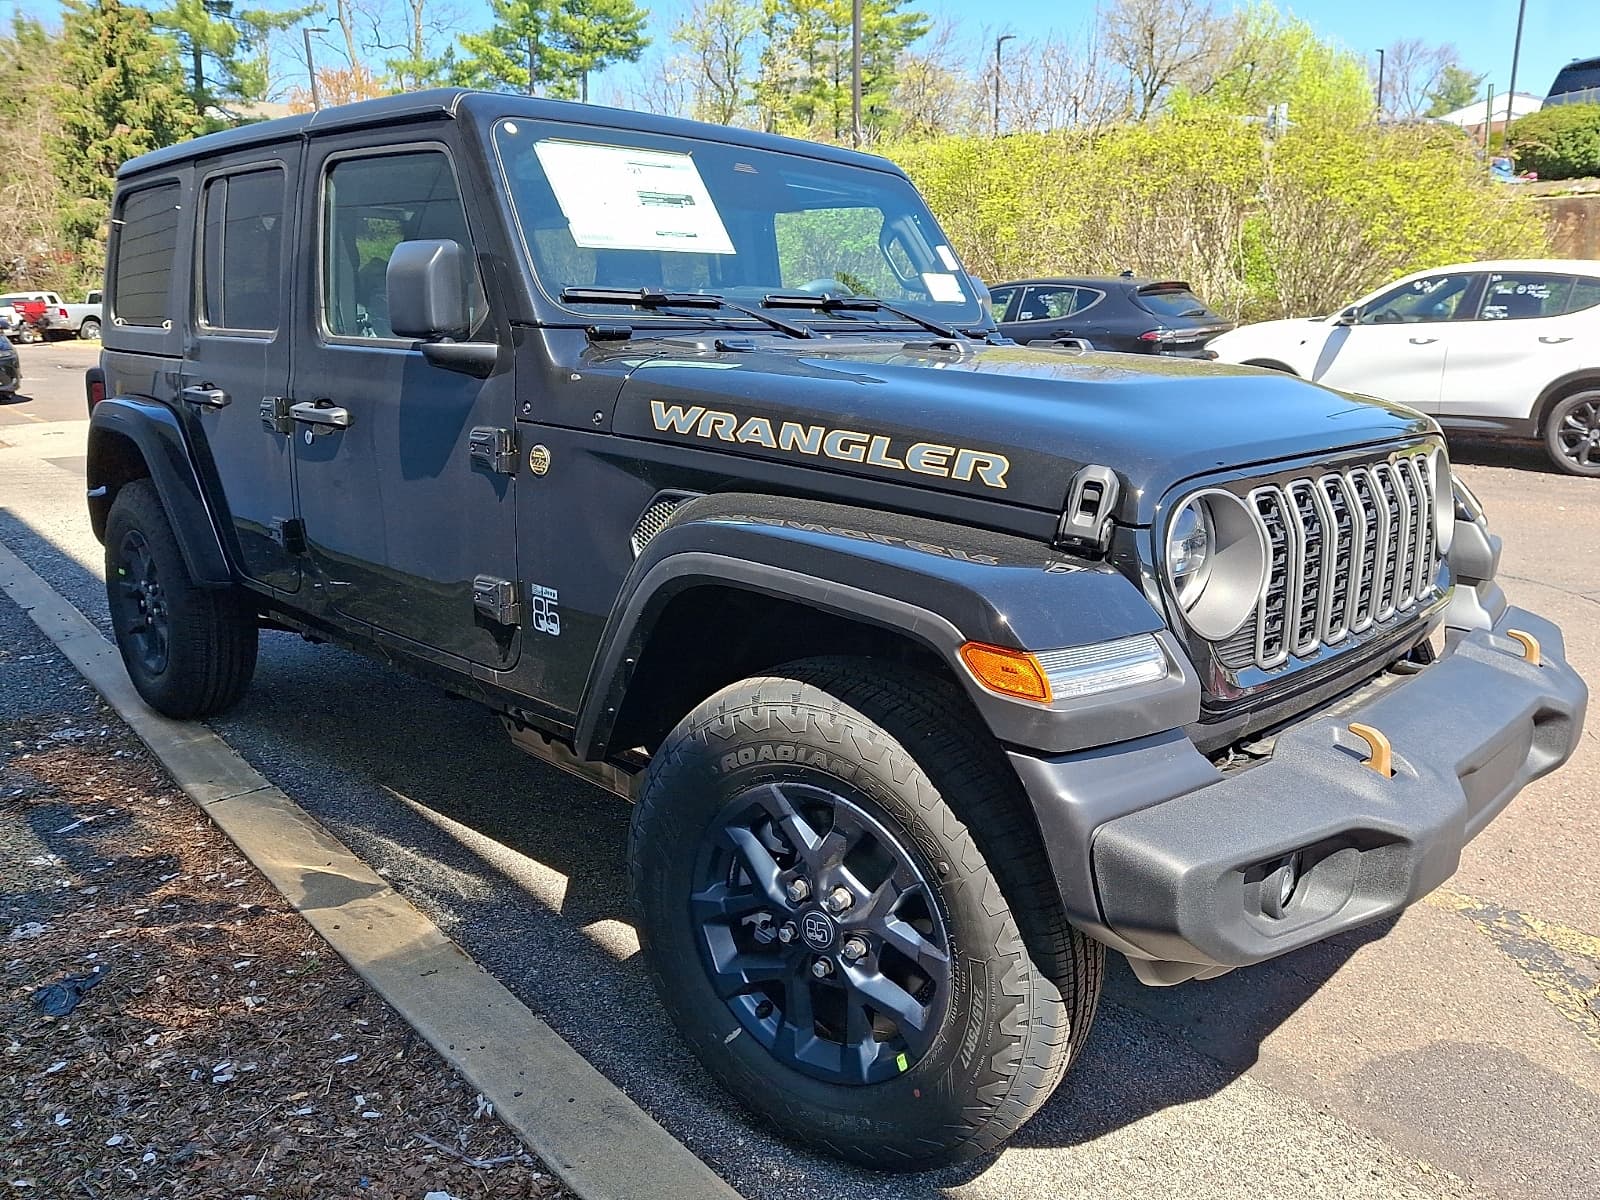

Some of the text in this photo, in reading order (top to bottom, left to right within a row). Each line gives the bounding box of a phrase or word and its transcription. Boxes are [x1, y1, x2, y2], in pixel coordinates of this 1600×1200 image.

[651, 400, 1010, 488] WRANGLER
[532, 595, 560, 636] 85
[720, 744, 855, 780] ROADIAN
[806, 919, 828, 943] 85
[961, 982, 984, 1070] 245/75R17
